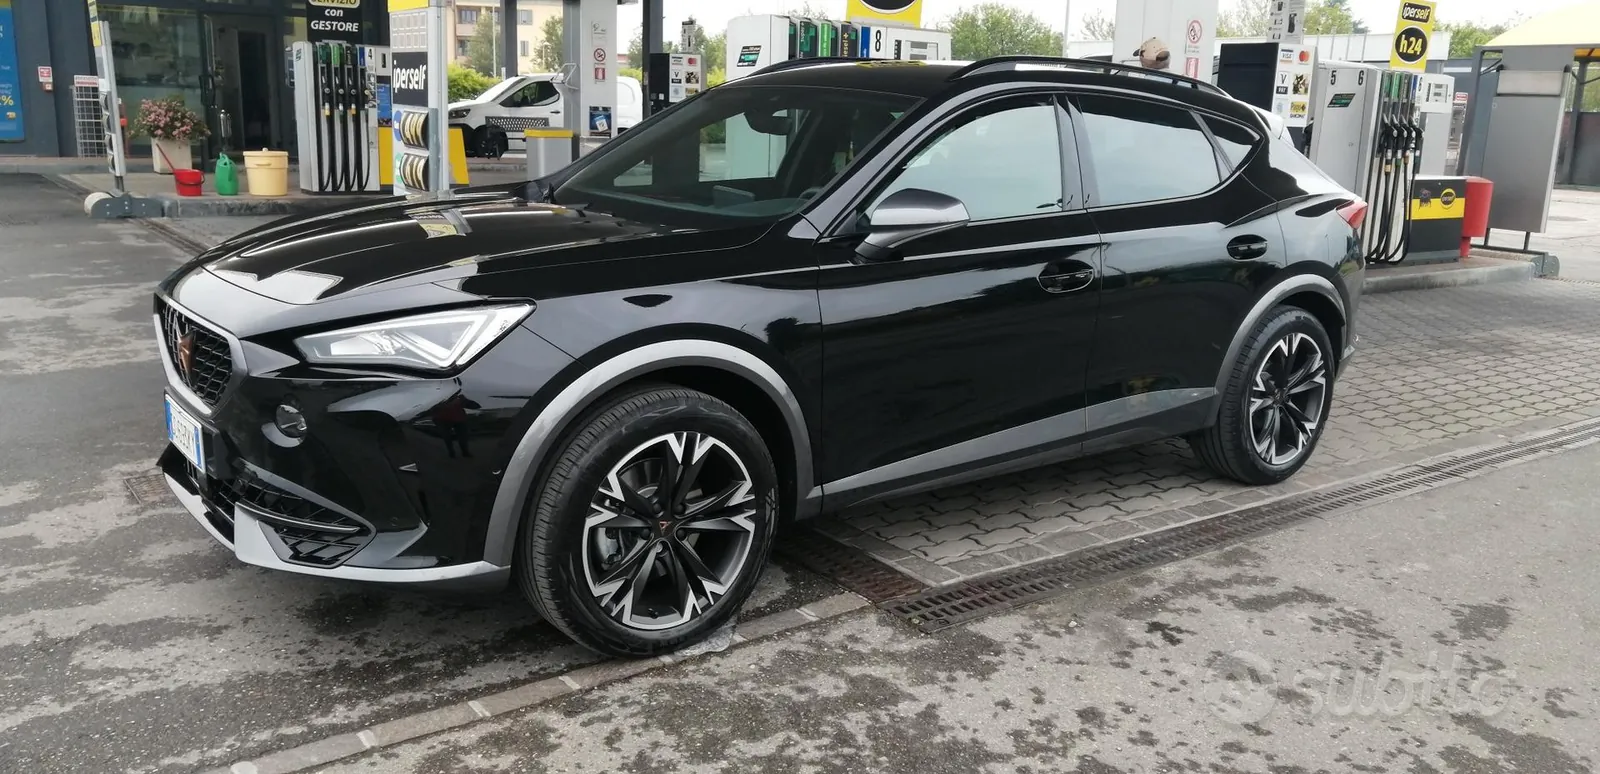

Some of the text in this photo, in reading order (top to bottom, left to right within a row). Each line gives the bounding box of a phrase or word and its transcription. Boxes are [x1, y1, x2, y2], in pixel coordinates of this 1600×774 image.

[324, 8, 344, 17] con
[1402, 3, 1430, 20] iperself
[310, 20, 359, 32] GESTORE
[875, 29, 882, 53] 8
[1399, 34, 1423, 56] h24
[392, 60, 427, 93] iperself
[1330, 70, 1337, 86] 5
[1358, 70, 1365, 86] 6
